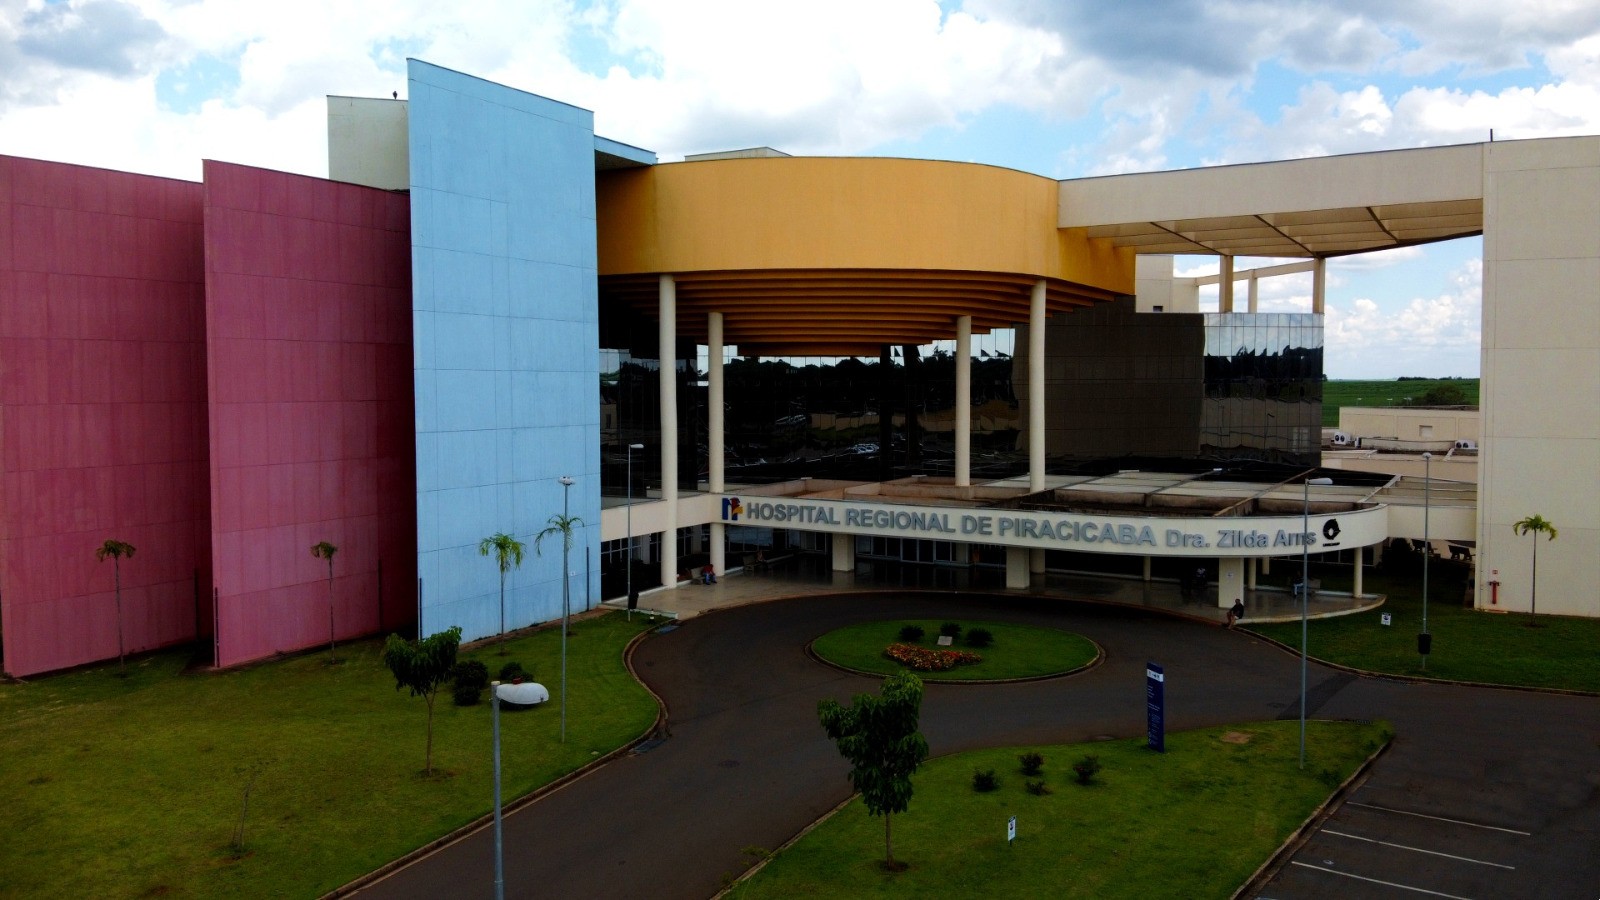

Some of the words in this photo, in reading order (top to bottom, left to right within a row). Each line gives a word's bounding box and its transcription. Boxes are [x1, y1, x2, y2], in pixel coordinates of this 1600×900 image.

[747, 502, 840, 525] HOSPITAL
[845, 508, 956, 533] REGIONAL
[961, 514, 992, 535] DE
[999, 517, 1156, 546] PIRACICABA
[1166, 529, 1210, 548] Dra.
[1216, 529, 1268, 549] Zilda
[1273, 529, 1317, 546] Arns
